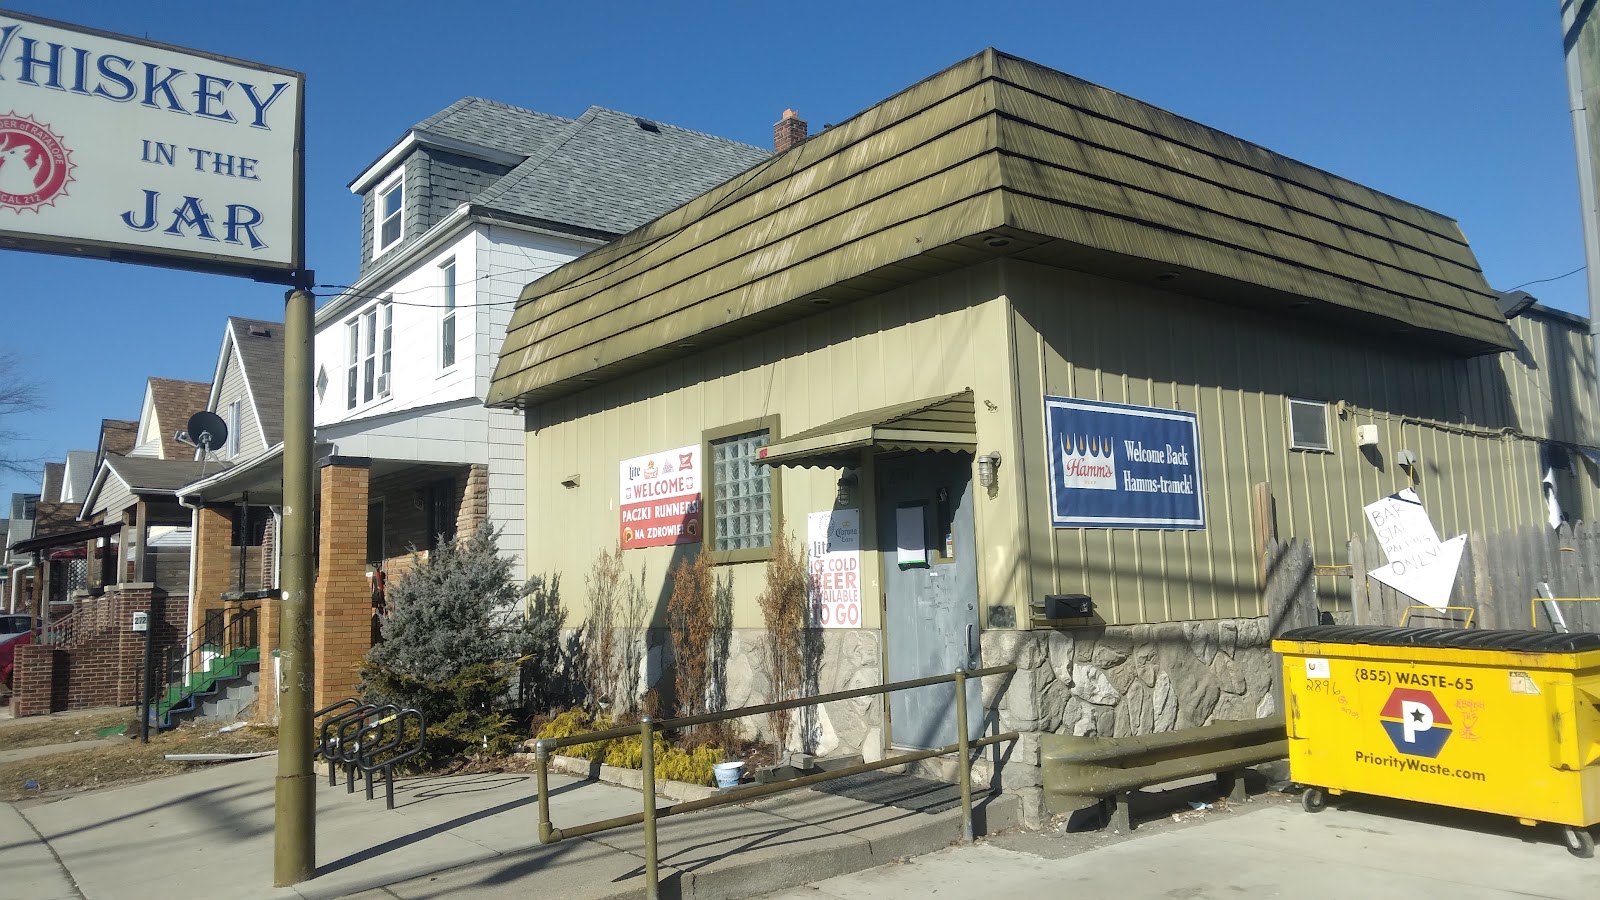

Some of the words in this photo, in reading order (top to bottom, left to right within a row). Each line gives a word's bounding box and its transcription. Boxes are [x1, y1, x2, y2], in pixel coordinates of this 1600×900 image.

[141, 139, 177, 167] IN
[188, 147, 261, 181] THE
[120, 189, 270, 250] JAR
[1124, 440, 1165, 465] Welcome
[1165, 443, 1189, 466] Back
[629, 465, 641, 481] Lite
[1066, 458, 1113, 478] Hamm's
[633, 477, 684, 499] WELCOME
[1123, 470, 1194, 495] Hamms-tramck!
[622, 506, 651, 523] PACZKI
[654, 500, 699, 519] RUNNERS!
[1371, 503, 1406, 527] BAR
[634, 528, 645, 540] NA
[647, 523, 684, 539] ZDROWIE!
[813, 540, 832, 559] Lite
[828, 557, 857, 572] COLD
[835, 603, 859, 626] GO
[1306, 678, 1342, 696] 2896
[1354, 667, 1393, 686] (855)
[1395, 671, 1475, 692] WASTE-65
[1355, 750, 1487, 783] PriorityWaste.com
